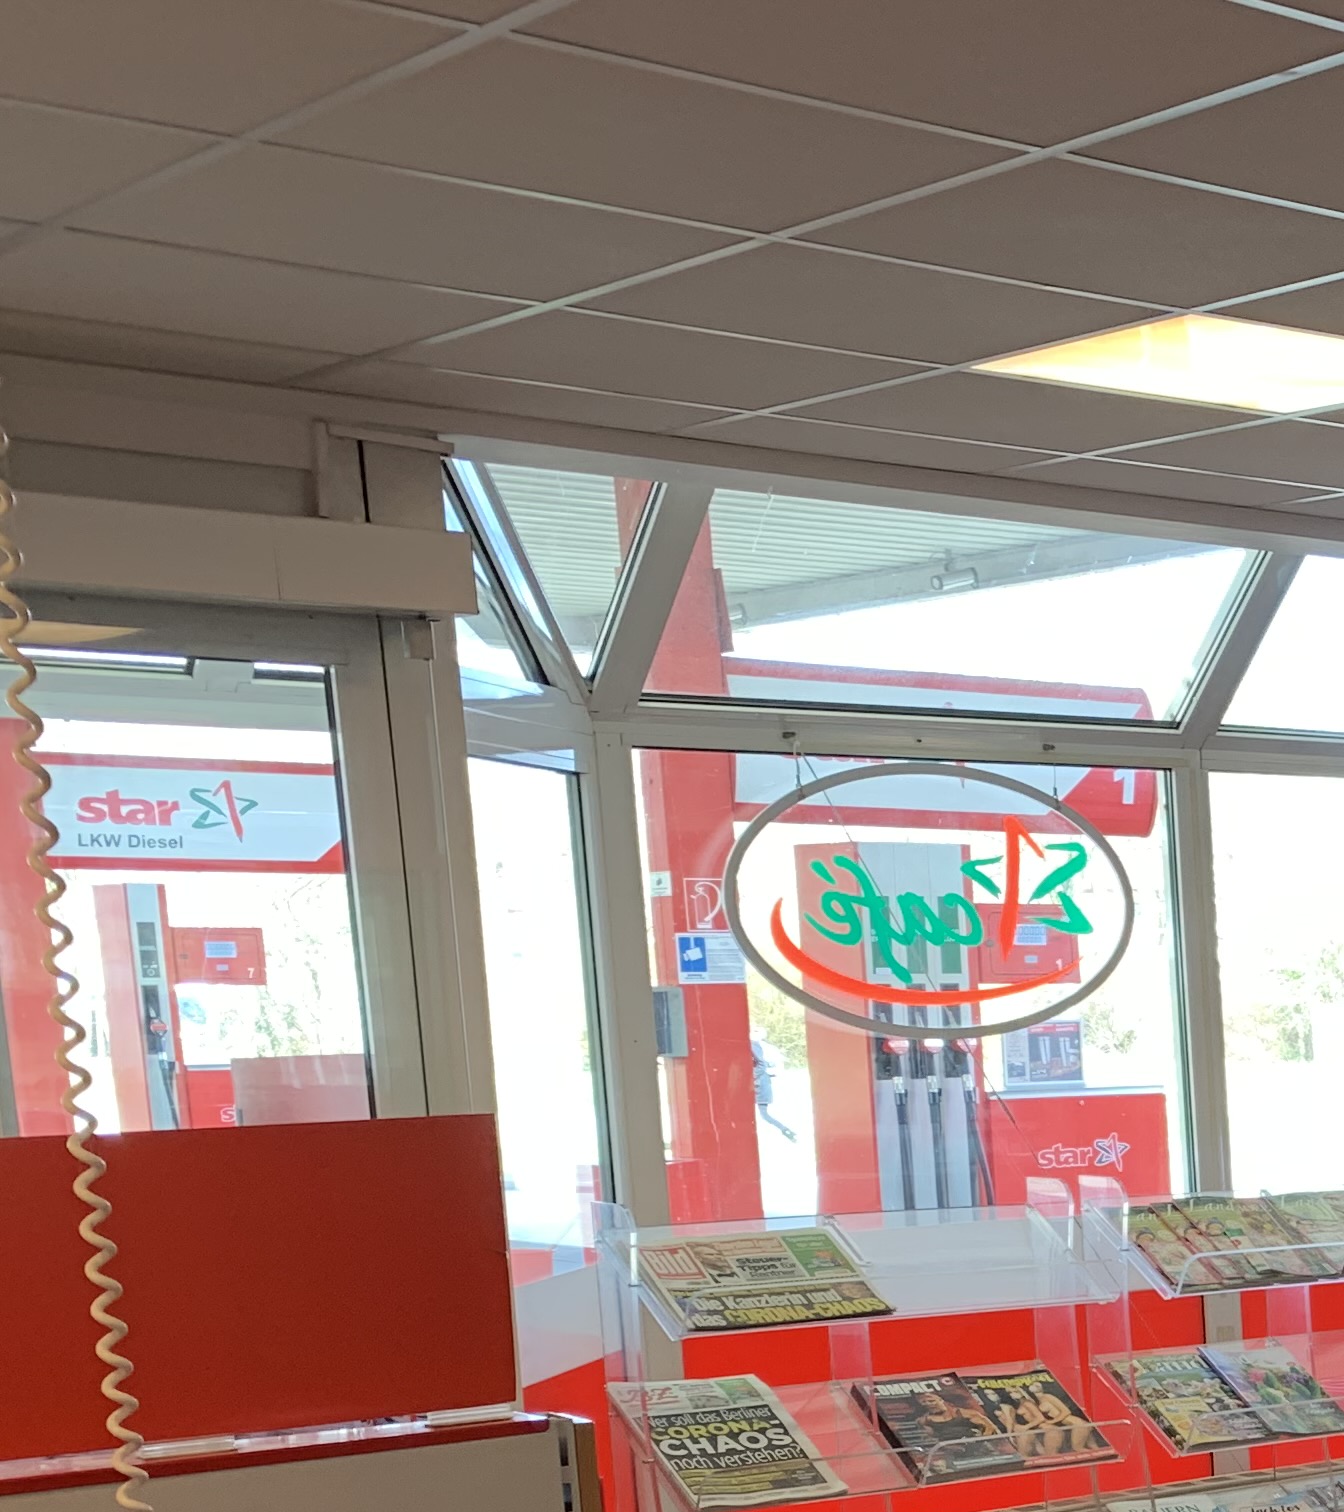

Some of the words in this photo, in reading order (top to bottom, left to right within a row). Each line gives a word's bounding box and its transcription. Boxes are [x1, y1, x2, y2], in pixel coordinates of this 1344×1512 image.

[1114, 770, 1136, 804] 1
[75, 790, 181, 826] star
[76, 834, 123, 848] LKW
[127, 834, 184, 849] Diesel
[1037, 1145, 1093, 1169] star
[720, 1292, 805, 1311] Kanzlerin
[806, 1288, 843, 1305] und
[723, 1298, 887, 1325] CORONA-CHAOS
[671, 1412, 694, 1426] soll
[701, 1411, 721, 1425] das
[721, 1406, 773, 1423] Berliner
[650, 1419, 781, 1441] CORONA-
[658, 1427, 793, 1456] CHAOS
[669, 1454, 713, 1472] noch
[714, 1443, 805, 1469] verstehen?
